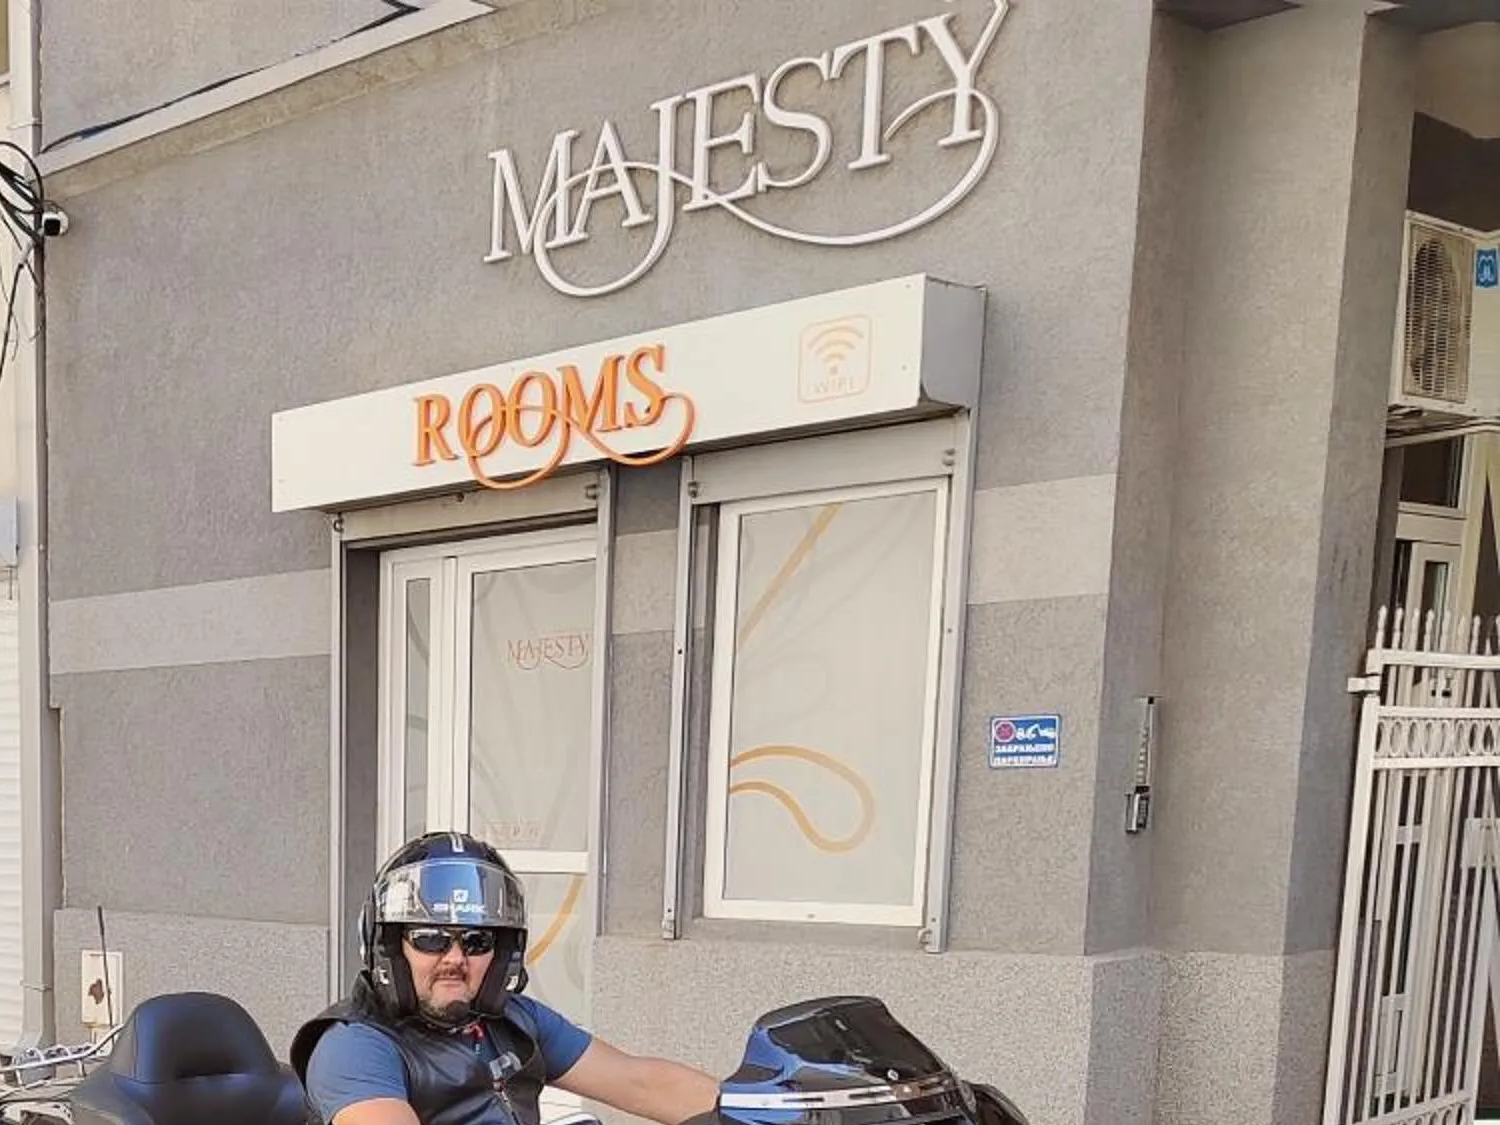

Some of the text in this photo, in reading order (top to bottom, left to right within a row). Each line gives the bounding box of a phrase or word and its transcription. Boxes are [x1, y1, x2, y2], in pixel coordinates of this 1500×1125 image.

[483, 0, 1013, 298] MAJESTY
[411, 343, 697, 490] ROOMS
[506, 632, 590, 671] MAJESTY
